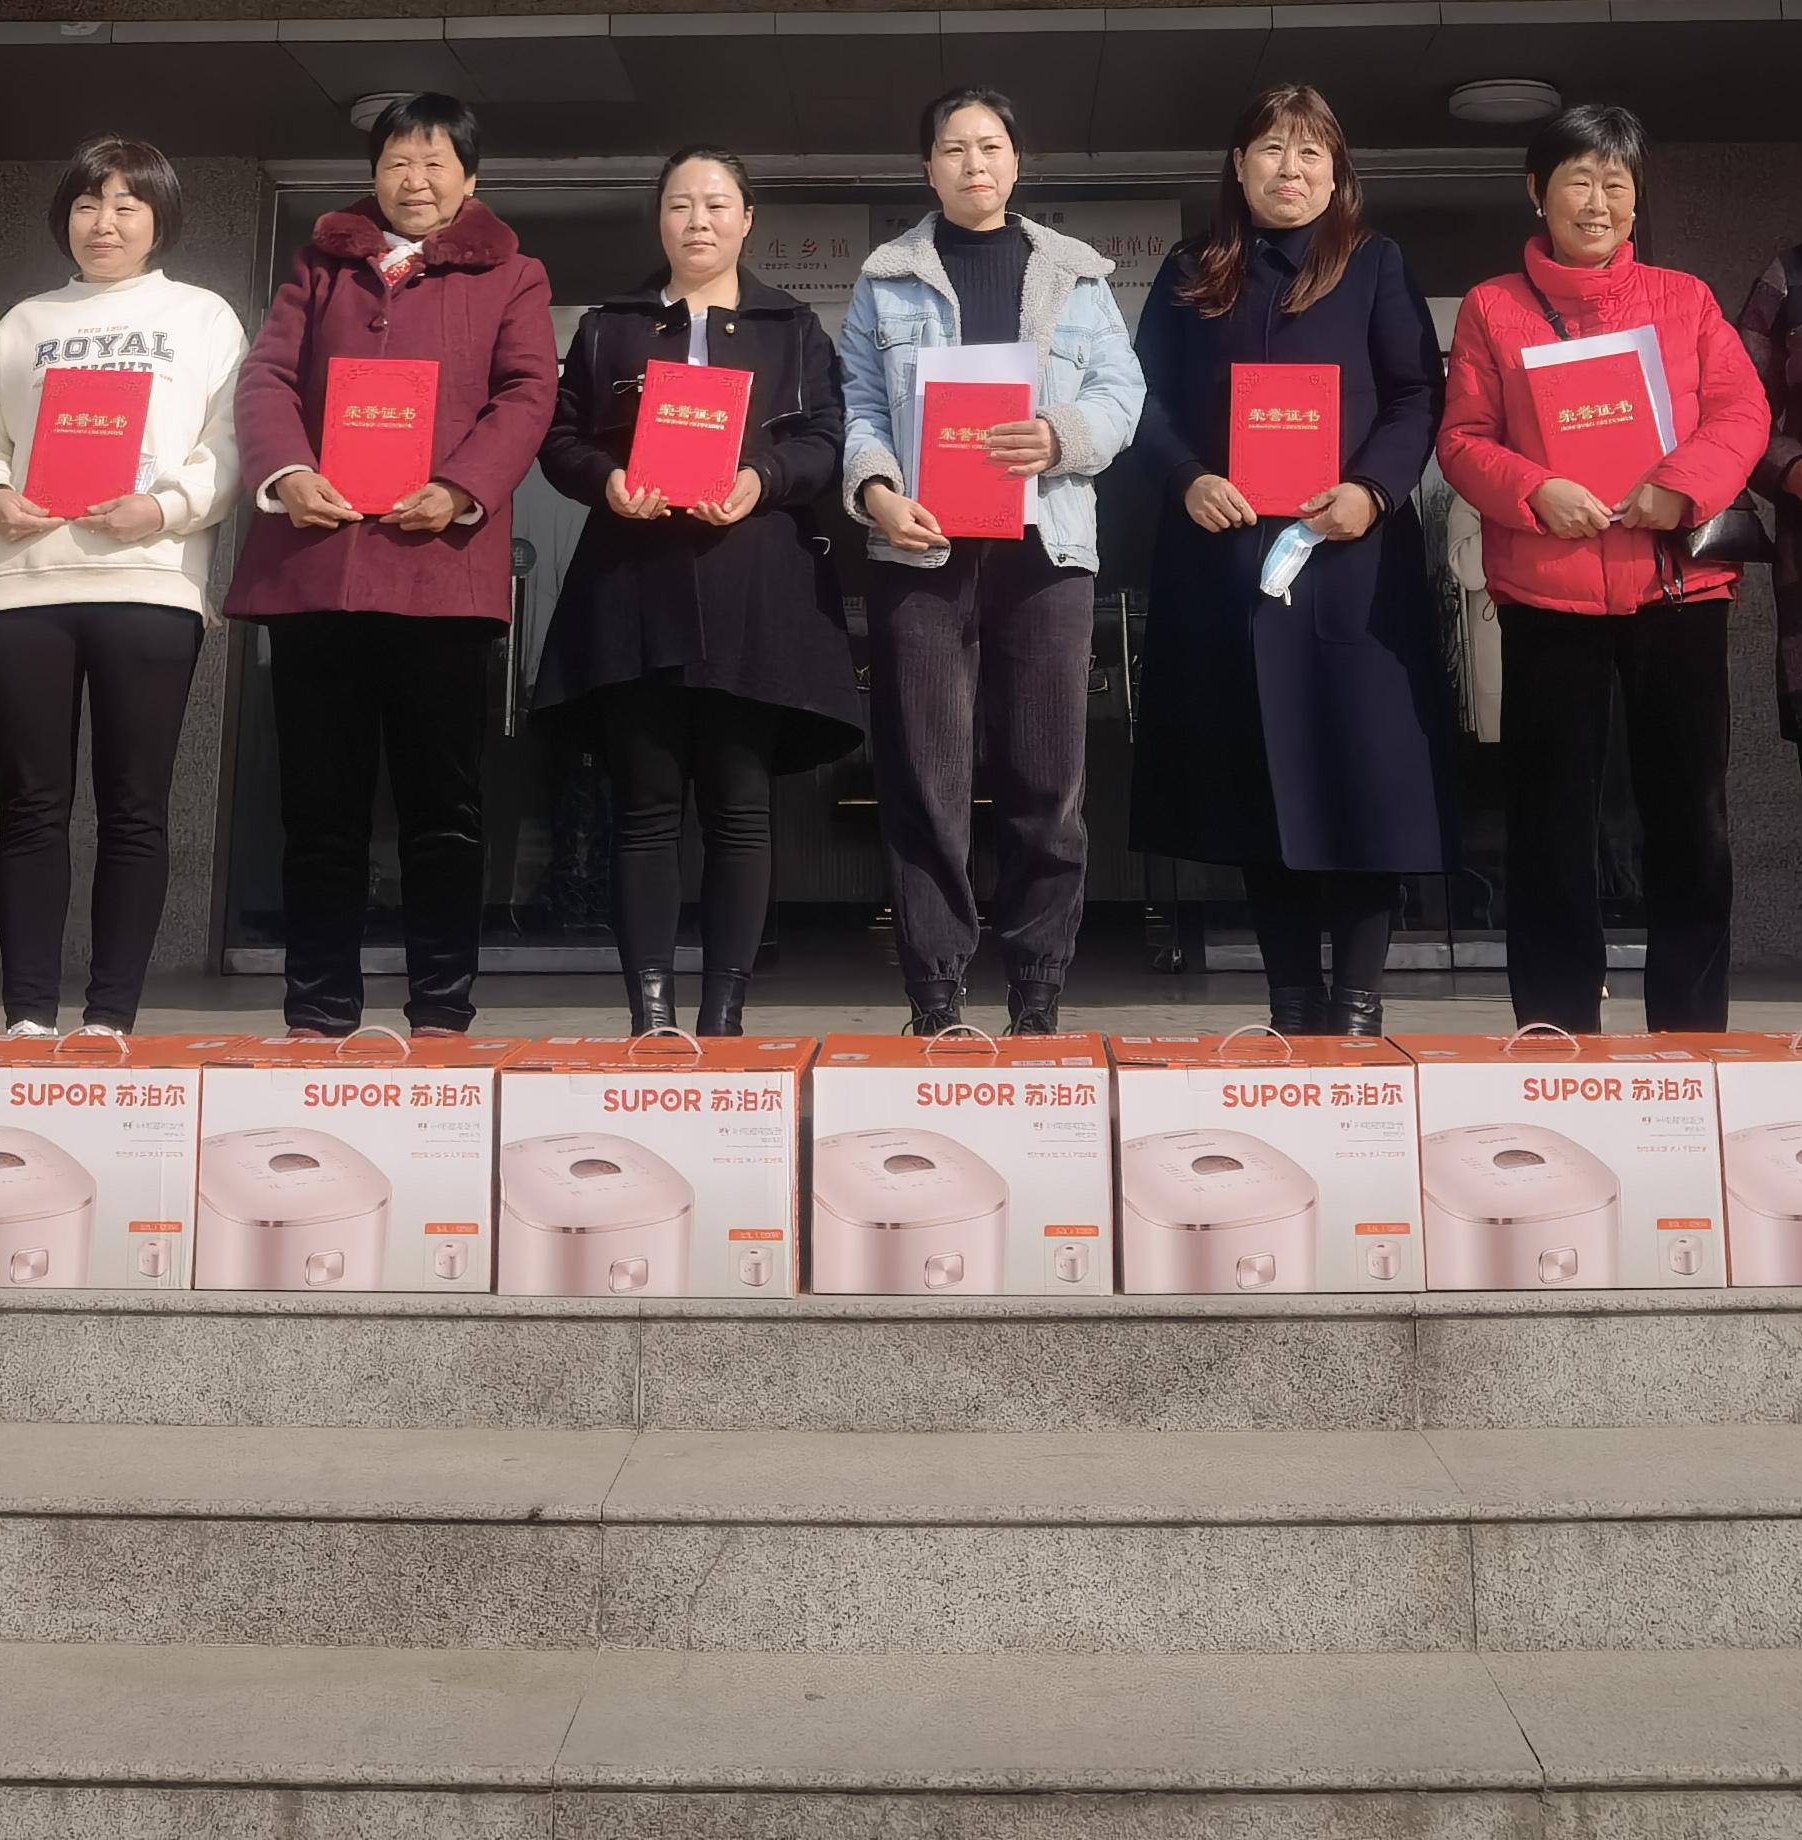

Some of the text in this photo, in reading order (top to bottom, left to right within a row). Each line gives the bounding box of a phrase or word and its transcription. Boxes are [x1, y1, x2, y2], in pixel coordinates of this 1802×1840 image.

[33, 331, 174, 371] ROYAL
[55, 413, 128, 429] 荣誉证书
[343, 405, 417, 421] 荣誉证书
[1248, 408, 1321, 423] 荣誉证书
[1557, 399, 1634, 424] 荣誉证书
[938, 426, 990, 442] 荣誉证
[10, 1082, 185, 1107] SUPOR 苏泊尔
[304, 1083, 481, 1108] SUPOR 苏泊尔
[604, 1088, 782, 1113] SUPOR 苏泊尔
[917, 1083, 1096, 1107] SUPOR 苏泊尔
[1223, 1083, 1402, 1108] SUPOR 苏泊尔
[1524, 1077, 1702, 1102] SUPOR 苏泊尔
